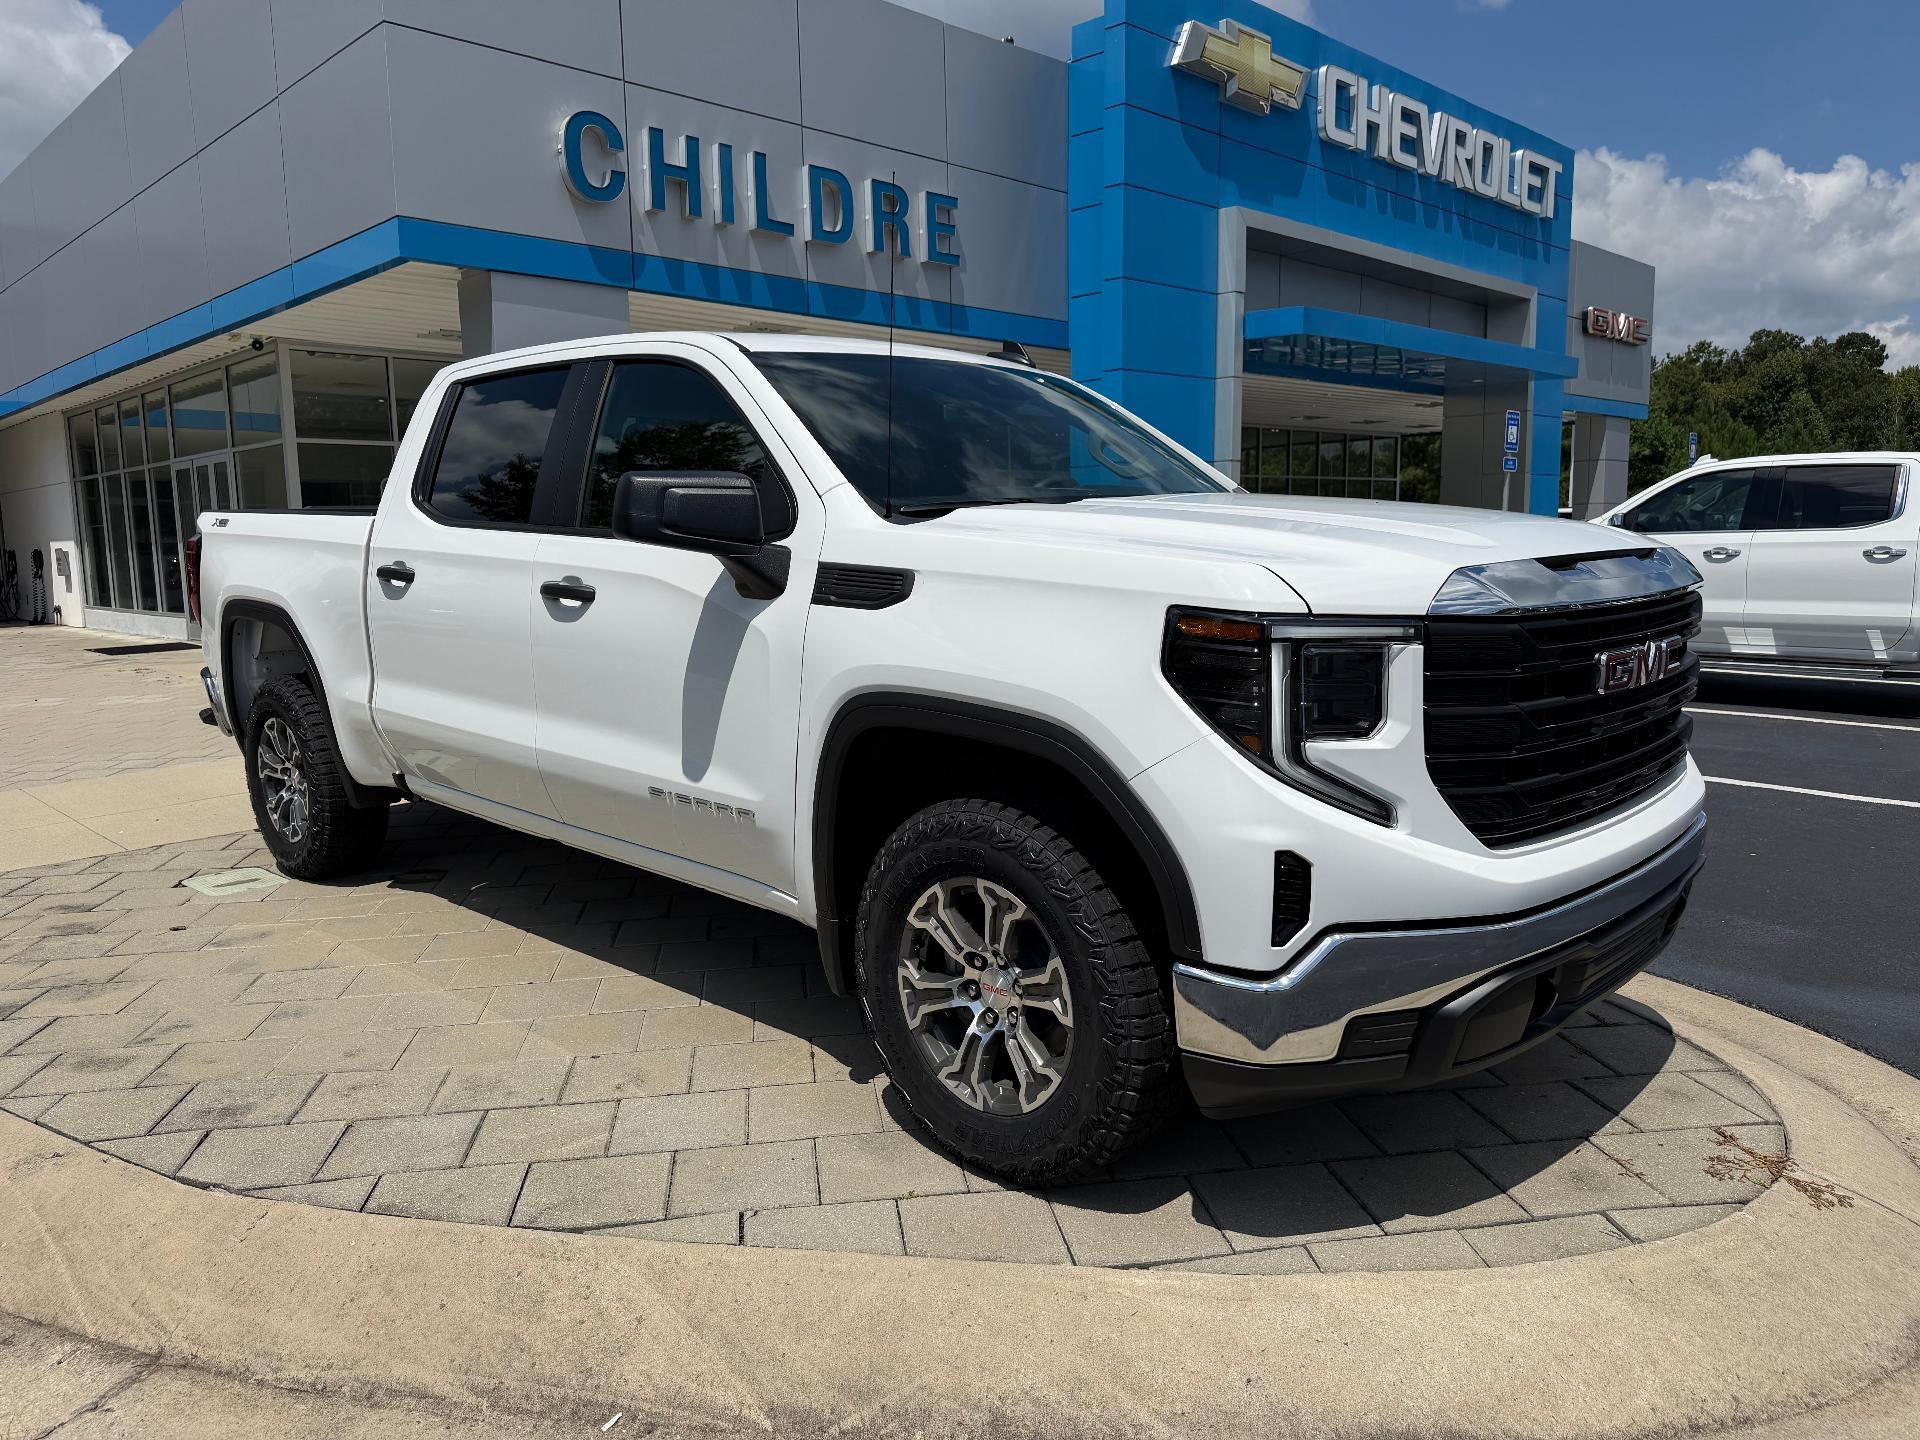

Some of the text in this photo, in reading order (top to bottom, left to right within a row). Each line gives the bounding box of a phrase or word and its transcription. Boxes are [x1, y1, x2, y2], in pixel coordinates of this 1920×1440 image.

[1318, 64, 1562, 219] CHEVROLET
[558, 110, 961, 267] CHILDRE
[1587, 306, 1649, 345] GMC
[1599, 636, 1682, 695] GMC
[647, 785, 757, 826] SIERRA
[982, 982, 1008, 997] GMC
